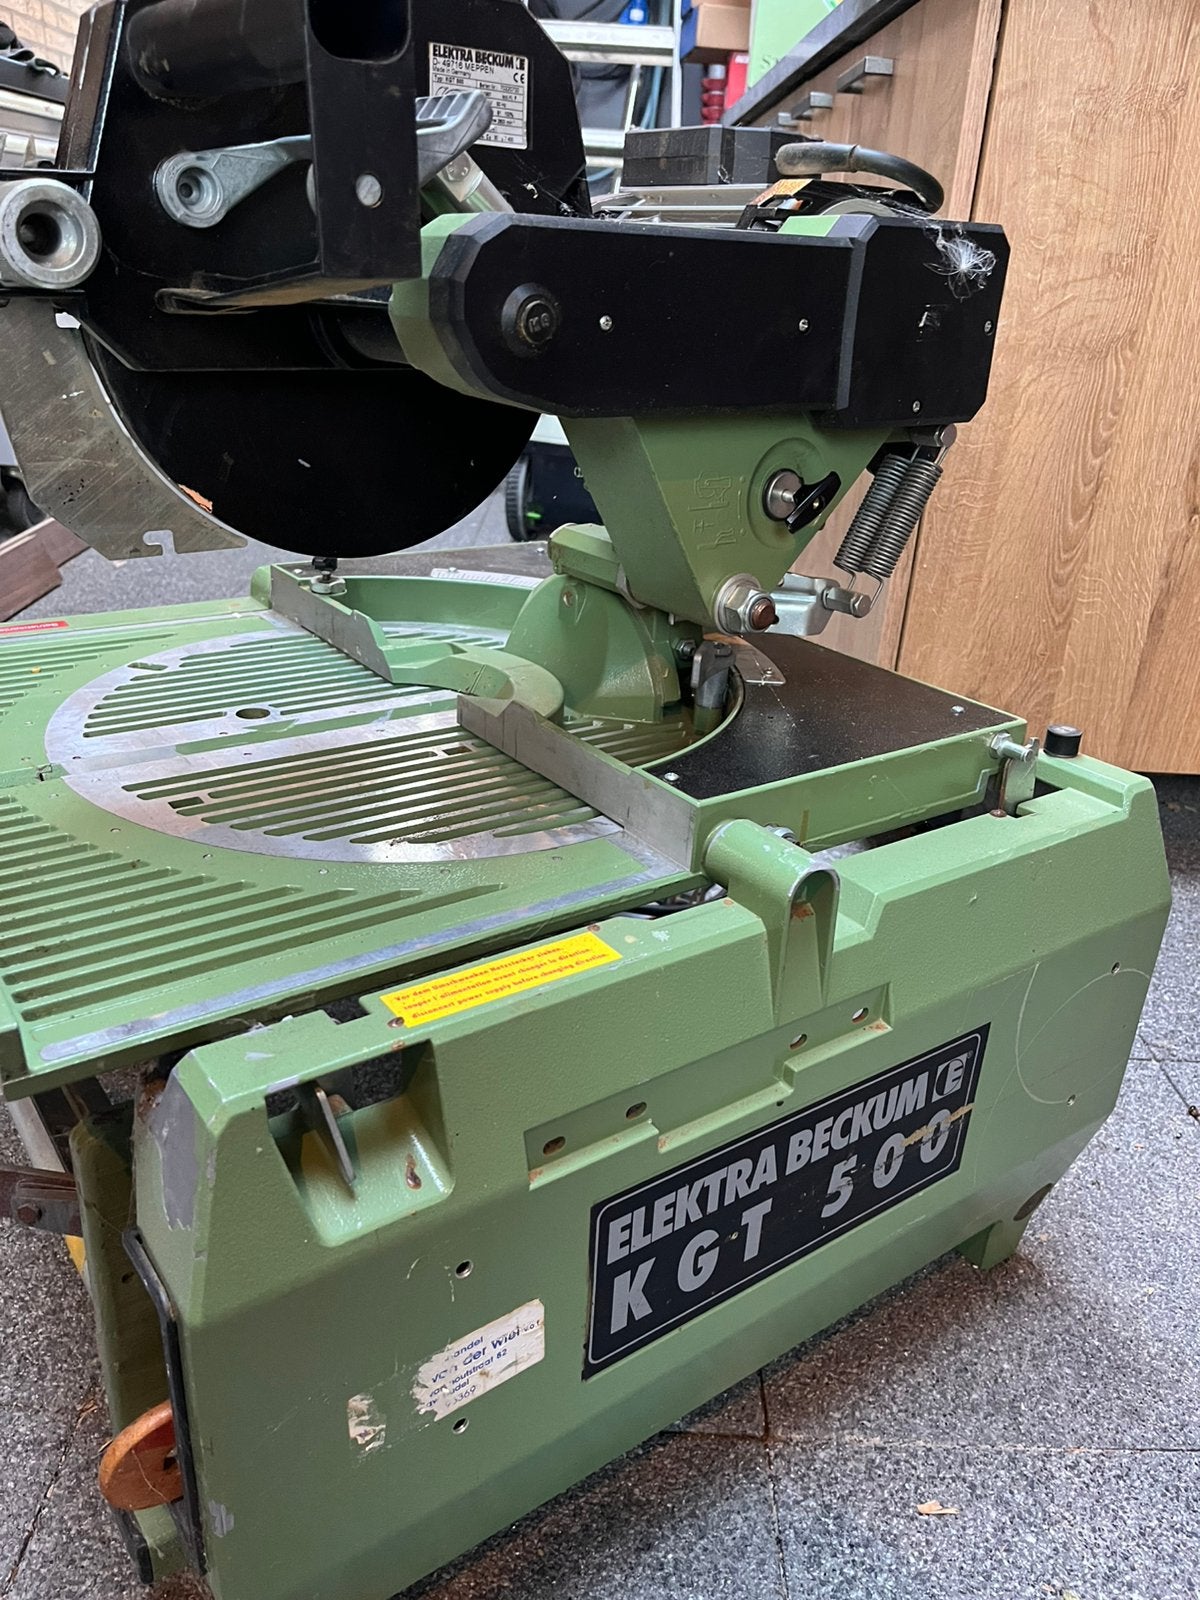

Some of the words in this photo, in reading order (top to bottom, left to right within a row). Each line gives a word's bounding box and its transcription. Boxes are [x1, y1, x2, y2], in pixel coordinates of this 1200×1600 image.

[432, 44, 473, 63] ELEKTRA
[475, 51, 514, 70] BECKUM
[464, 62, 494, 75] MEPPEN
[451, 68, 472, 79] Germany
[606, 1144, 777, 1265] ELEKTRA
[785, 1071, 930, 1176] BECKUM
[452, 1335, 484, 1358] andel
